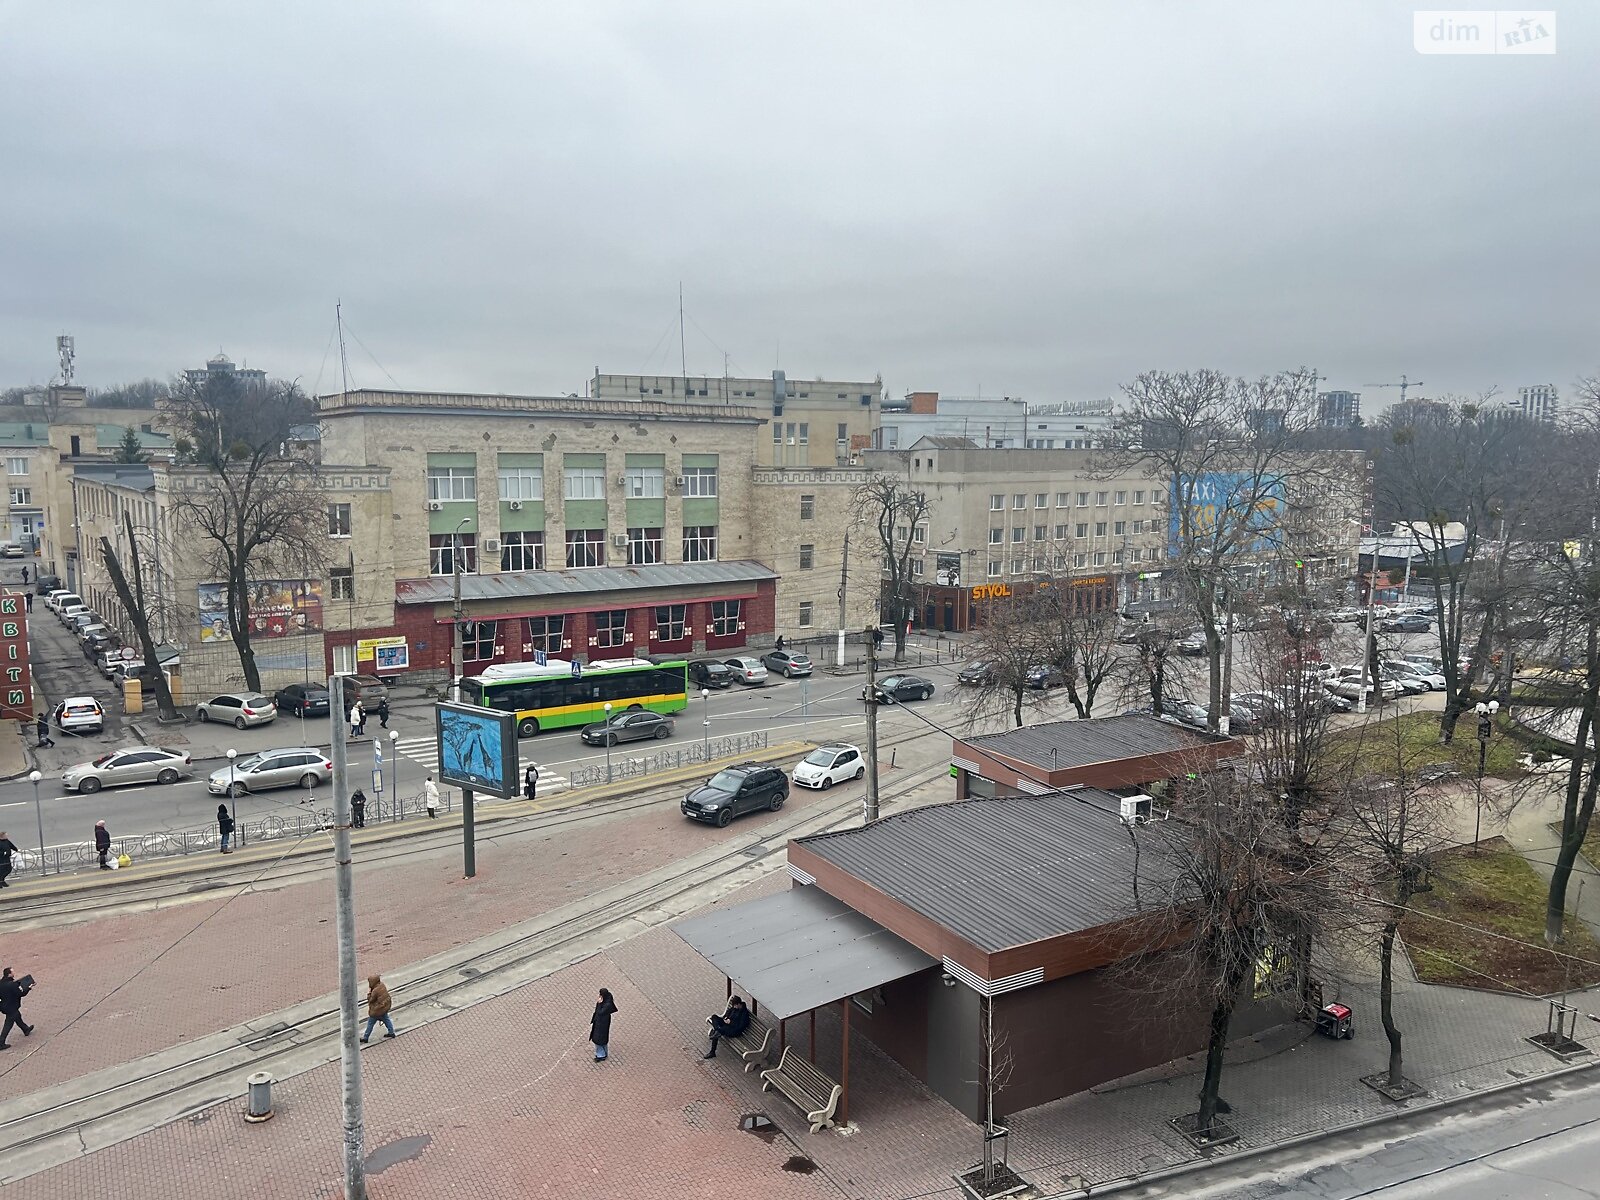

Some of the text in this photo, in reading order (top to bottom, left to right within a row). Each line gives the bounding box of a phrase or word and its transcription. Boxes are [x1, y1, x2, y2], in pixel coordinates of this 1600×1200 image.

[1181, 481, 1216, 501] TAXI
[972, 583, 1011, 600] STVOL
[1, 598, 25, 704] КВІТИ
